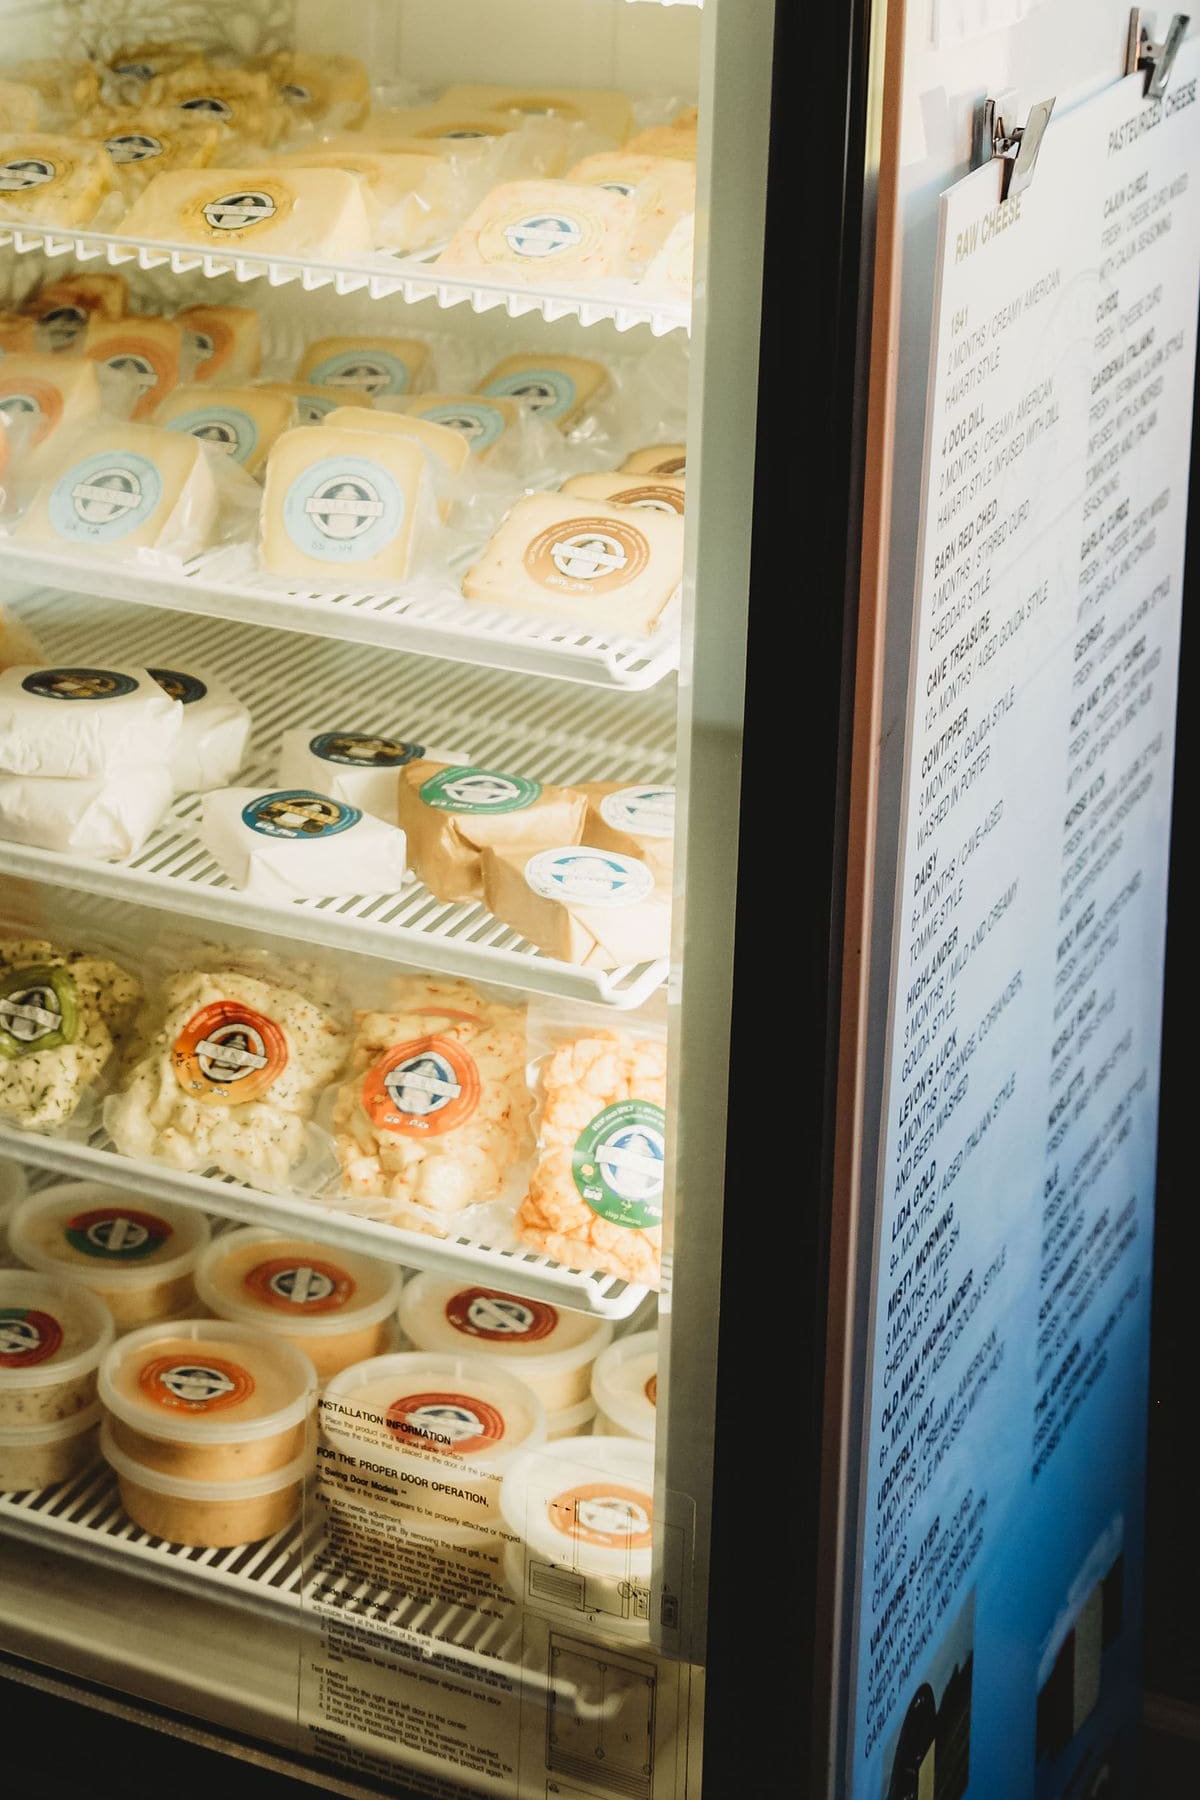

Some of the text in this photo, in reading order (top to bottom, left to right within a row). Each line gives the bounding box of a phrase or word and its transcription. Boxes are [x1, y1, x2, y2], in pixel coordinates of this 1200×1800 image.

[1107, 76, 1196, 159] PASTEURIZED CHEESE
[955, 192, 1021, 263] RAW CHEESE
[951, 306, 967, 337] 1841
[954, 326, 984, 369] MONTHS
[992, 296, 1021, 337] CREAMY
[1023, 265, 1060, 312] AMERICAN
[945, 347, 999, 412] HAVARTI STYLE
[937, 399, 1060, 531] HAVARTI STYLE INFUSED WITH DILL
[946, 443, 977, 487] MONTHS
[984, 409, 1013, 452] CREAMY
[1016, 374, 1053, 423] AMERICAN
[949, 419, 965, 450] DOG
[968, 402, 984, 433] DILL
[934, 498, 997, 577] BARN RED CHED
[929, 570, 990, 651] CHEDDAR STYLE
[938, 559, 969, 607] MONTHS
[924, 579, 1048, 731] 12+ MONTHS AGED GOUDA STYLE
[926, 611, 989, 696] CAVE TREASURE
[921, 707, 968, 779] COWTIPPER
[925, 752, 957, 806] MONTHS
[964, 713, 990, 759] GOUDA
[993, 685, 1014, 725] STYLE
[917, 795, 948, 849] WASHED
[961, 744, 989, 794] PORTER
[914, 850, 937, 896] DAISY
[922, 860, 954, 916] MONTHS
[910, 879, 963, 965] TOMME STYLE
[907, 927, 957, 1012] HIGHLANDER
[911, 977, 943, 1036] MONTHS
[950, 942, 968, 982] MILD
[971, 920, 985, 955] AND
[899, 1028, 957, 1127] LEVON'S LUCK
[902, 992, 955, 1082] GOUDA STYLE
[895, 1074, 968, 1196] AND BEER WASHED
[903, 1088, 936, 1152] MONTHS
[892, 1159, 935, 1241] LIDA GOLD
[902, 1191, 934, 1256] MONTHS
[943, 1149, 962, 1193] AGED
[887, 1202, 953, 1320] MISTY MORNING
[892, 1275, 925, 1343] MONTHS
[933, 1221, 959, 1277] WELSH
[881, 1267, 972, 1432] OLD MAN HIGHLANDER
[883, 1269, 947, 1389] CHEDDAR STYLE
[318, 1399, 450, 1445] INSTALLATION INFORMATION
[877, 1397, 934, 1510] UDDERLY HOT
[891, 1376, 924, 1447] MONTHS
[316, 1447, 488, 1506] FOR THE PROPER DOOR OPERATION,
[324, 1467, 397, 1495] Swing Door Models
[882, 1458, 916, 1530] MONTHS
[874, 1507, 906, 1579] HAVARTI
[908, 1461, 931, 1516] STYLE
[870, 1515, 939, 1656] VAMPIRE SLAYER
